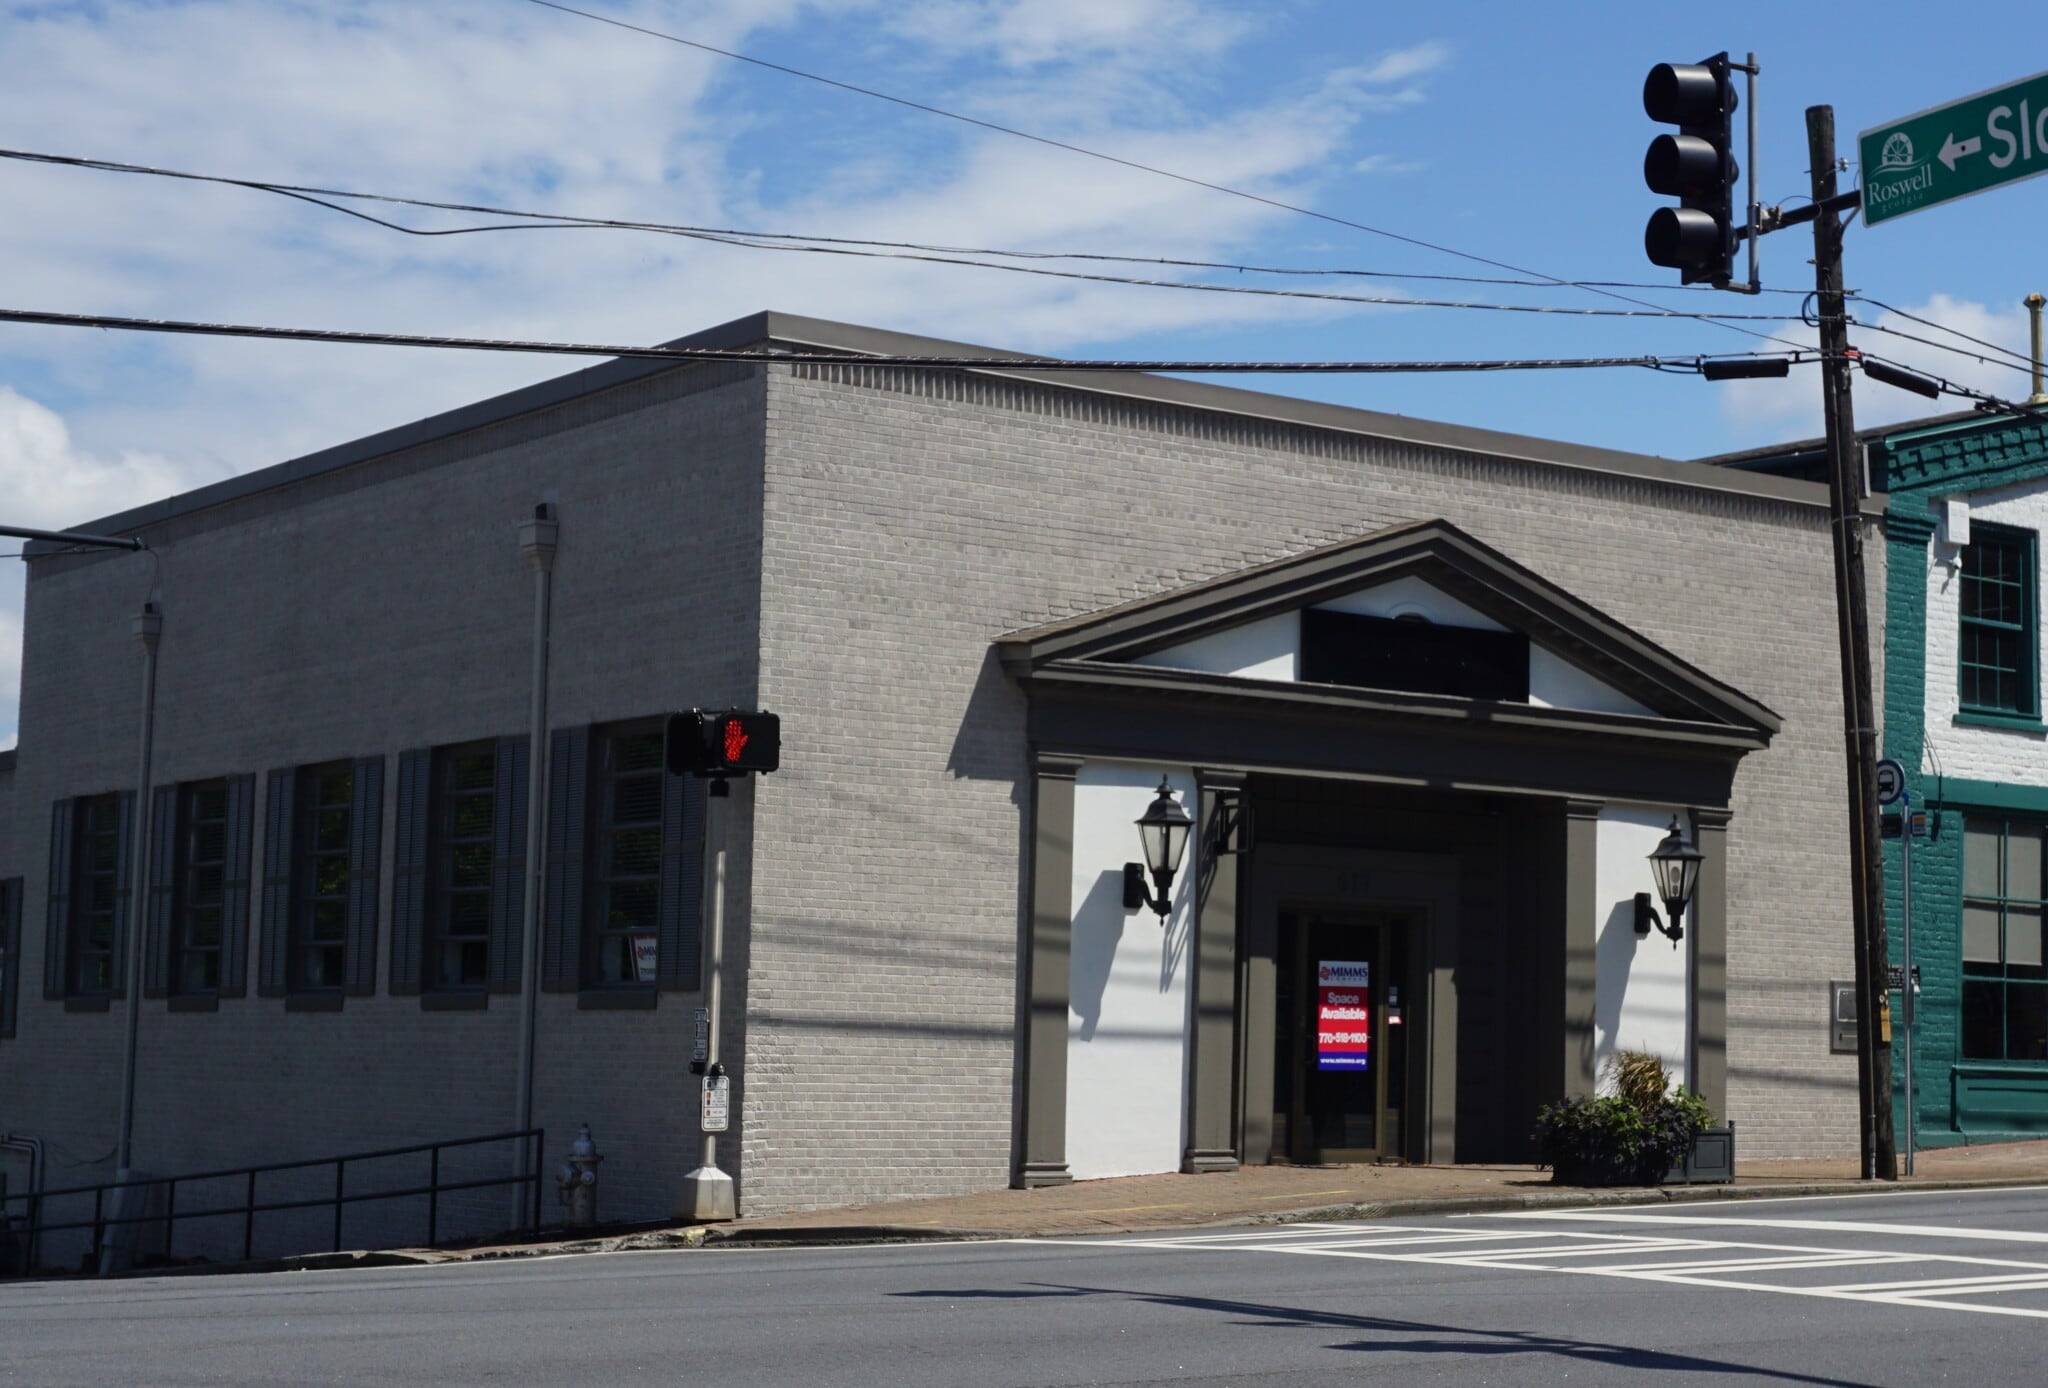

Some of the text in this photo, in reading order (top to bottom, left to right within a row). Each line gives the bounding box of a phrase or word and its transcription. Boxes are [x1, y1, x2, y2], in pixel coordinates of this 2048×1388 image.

[1867, 163, 1934, 206] Roswell
[1331, 966, 1368, 977] MIMMS
[1327, 991, 1359, 1006] Space
[1320, 1006, 1366, 1020] Available
